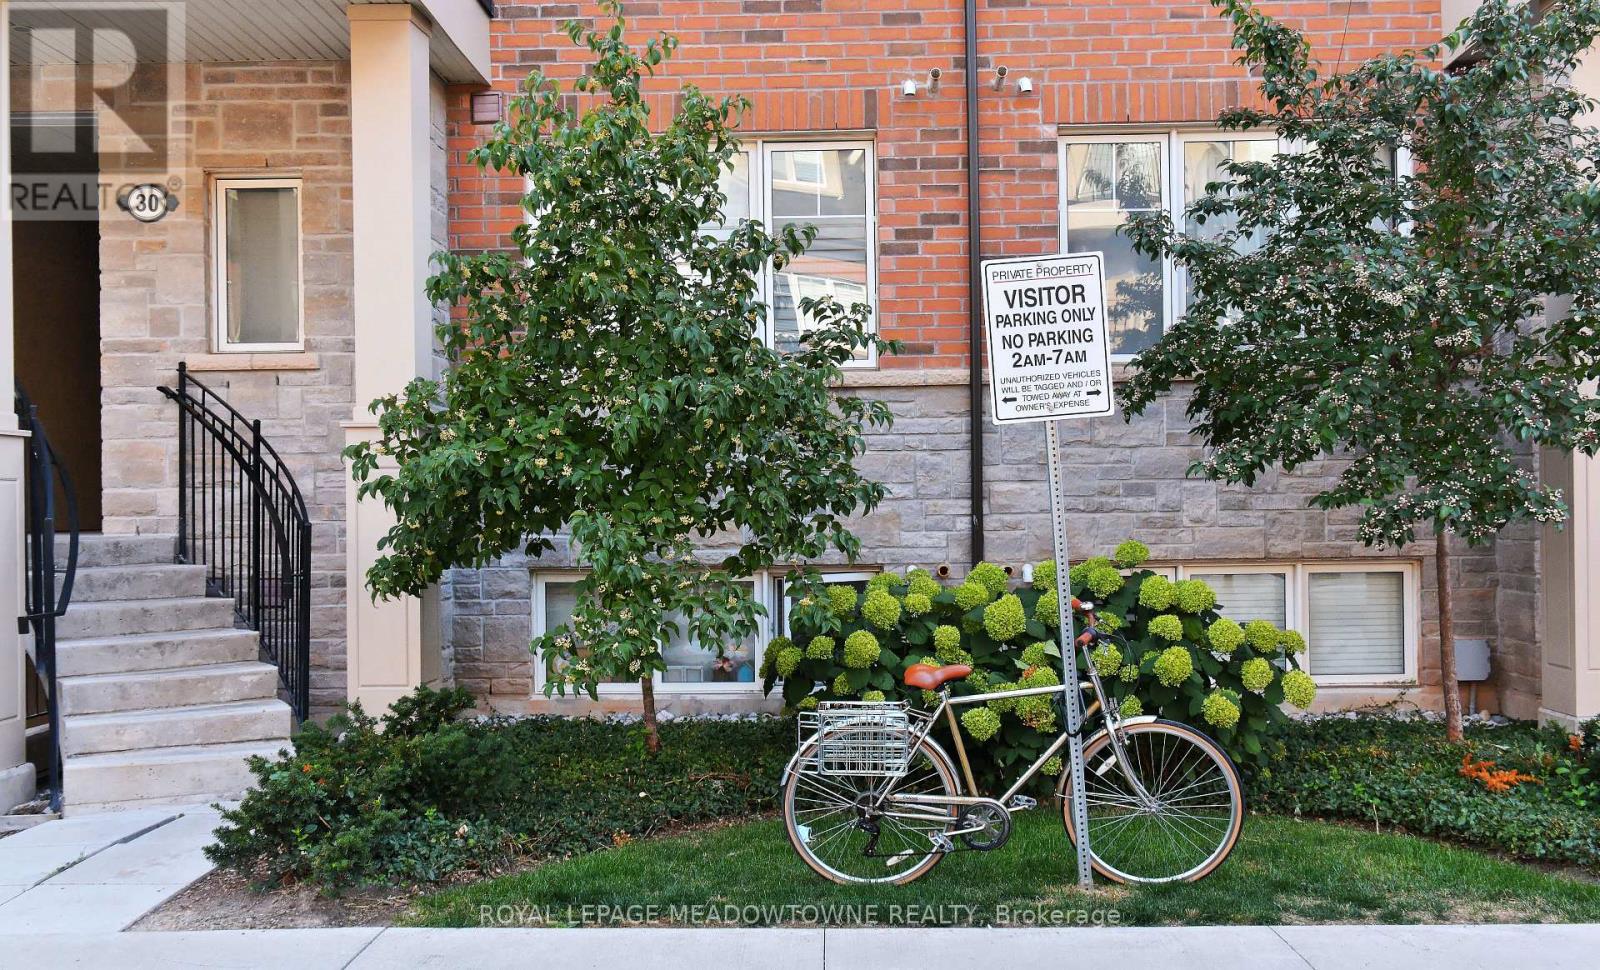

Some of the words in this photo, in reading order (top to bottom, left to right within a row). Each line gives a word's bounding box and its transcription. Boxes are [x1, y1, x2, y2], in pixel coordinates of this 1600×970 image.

[136, 194, 159, 212] 30
[992, 269, 1033, 280] PRIVATE
[1036, 264, 1093, 276] PROPERTY
[1003, 285, 1085, 308] VISITOR
[996, 311, 1057, 328] PARKING
[1061, 306, 1096, 324] ONLY
[1001, 333, 1024, 350] NO
[1028, 328, 1094, 348] PARKING
[1012, 349, 1087, 368] 2AM-7AM
[1000, 373, 1060, 384] UNAUTHORIZED
[1062, 369, 1101, 380] VEHICLES
[1001, 385, 1020, 394] WILL
[1021, 385, 1032, 393] BE
[1033, 382, 1065, 392] TAGGED
[1066, 381, 1084, 389] AND
[1089, 379, 1102, 387] OR
[1015, 402, 1052, 412] OWNER'S
[1053, 398, 1090, 409] EXPENSE
[1022, 392, 1050, 402] TOWED
[1051, 391, 1071, 399] AWAY
